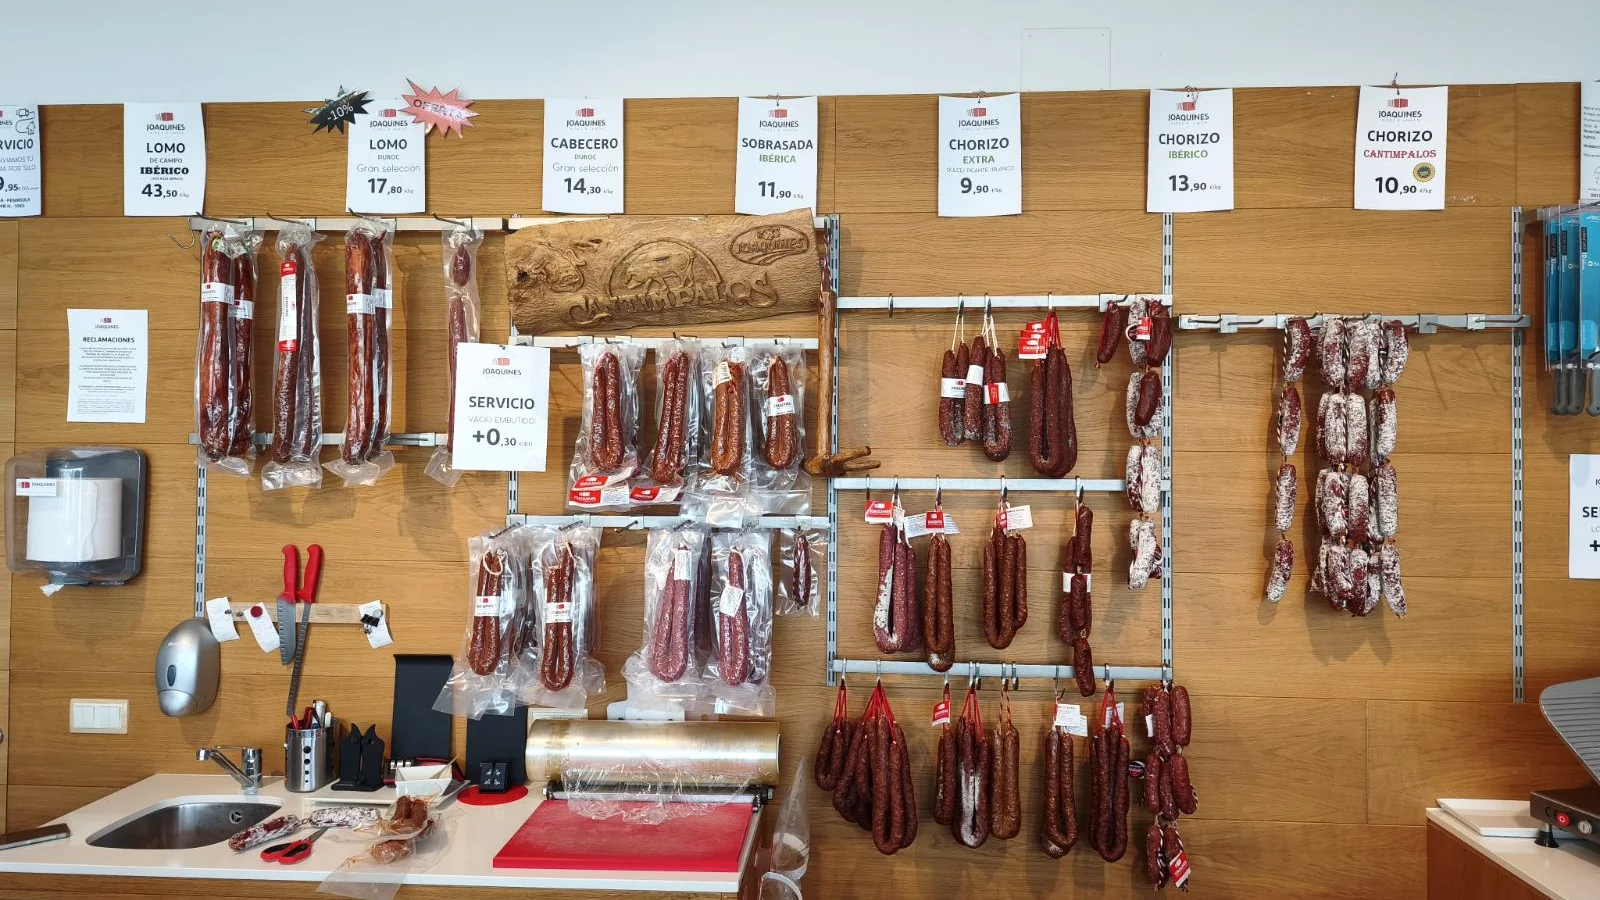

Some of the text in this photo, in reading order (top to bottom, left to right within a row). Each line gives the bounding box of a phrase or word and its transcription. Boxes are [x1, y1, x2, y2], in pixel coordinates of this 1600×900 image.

[327, 102, 354, 120] -10%
[413, 99, 464, 119] OFERTA
[1378, 111, 1422, 119] JOAQUINES
[566, 119, 606, 127] JOAQUINES
[958, 119, 1000, 127] JOAQUINES
[1168, 113, 1210, 121] JOAQUINES
[759, 120, 799, 128] JOAQUINES
[1158, 132, 1220, 145] CHORIZO
[1367, 130, 1433, 142] CHORIZO
[146, 142, 186, 153] LOMO
[369, 139, 408, 150] LOMO
[550, 137, 618, 150] CABECERO
[741, 137, 814, 150] SOBRASADA
[949, 137, 1009, 150] CHORIZO
[759, 153, 796, 163] IBÉRICA
[962, 155, 995, 164] EXTRA
[1168, 149, 1208, 159] IBÉRICO
[1363, 149, 1437, 158] CANTIMPALOS
[140, 165, 189, 175] IBÉRICO
[356, 163, 421, 173] Gran selección
[552, 162, 619, 173] Gran selección
[367, 178, 402, 195] 17,80
[564, 177, 601, 195] 14,30
[960, 177, 989, 195] 9,90
[1168, 174, 1207, 192] 13,90
[1375, 176, 1417, 195] 10,90
[141, 183, 178, 198] 43,50
[758, 181, 792, 199] 11,90
[568, 271, 779, 326] CANTIMPALOS
[482, 368, 522, 376] JOAQUINES
[468, 396, 535, 410] SERVICIO
